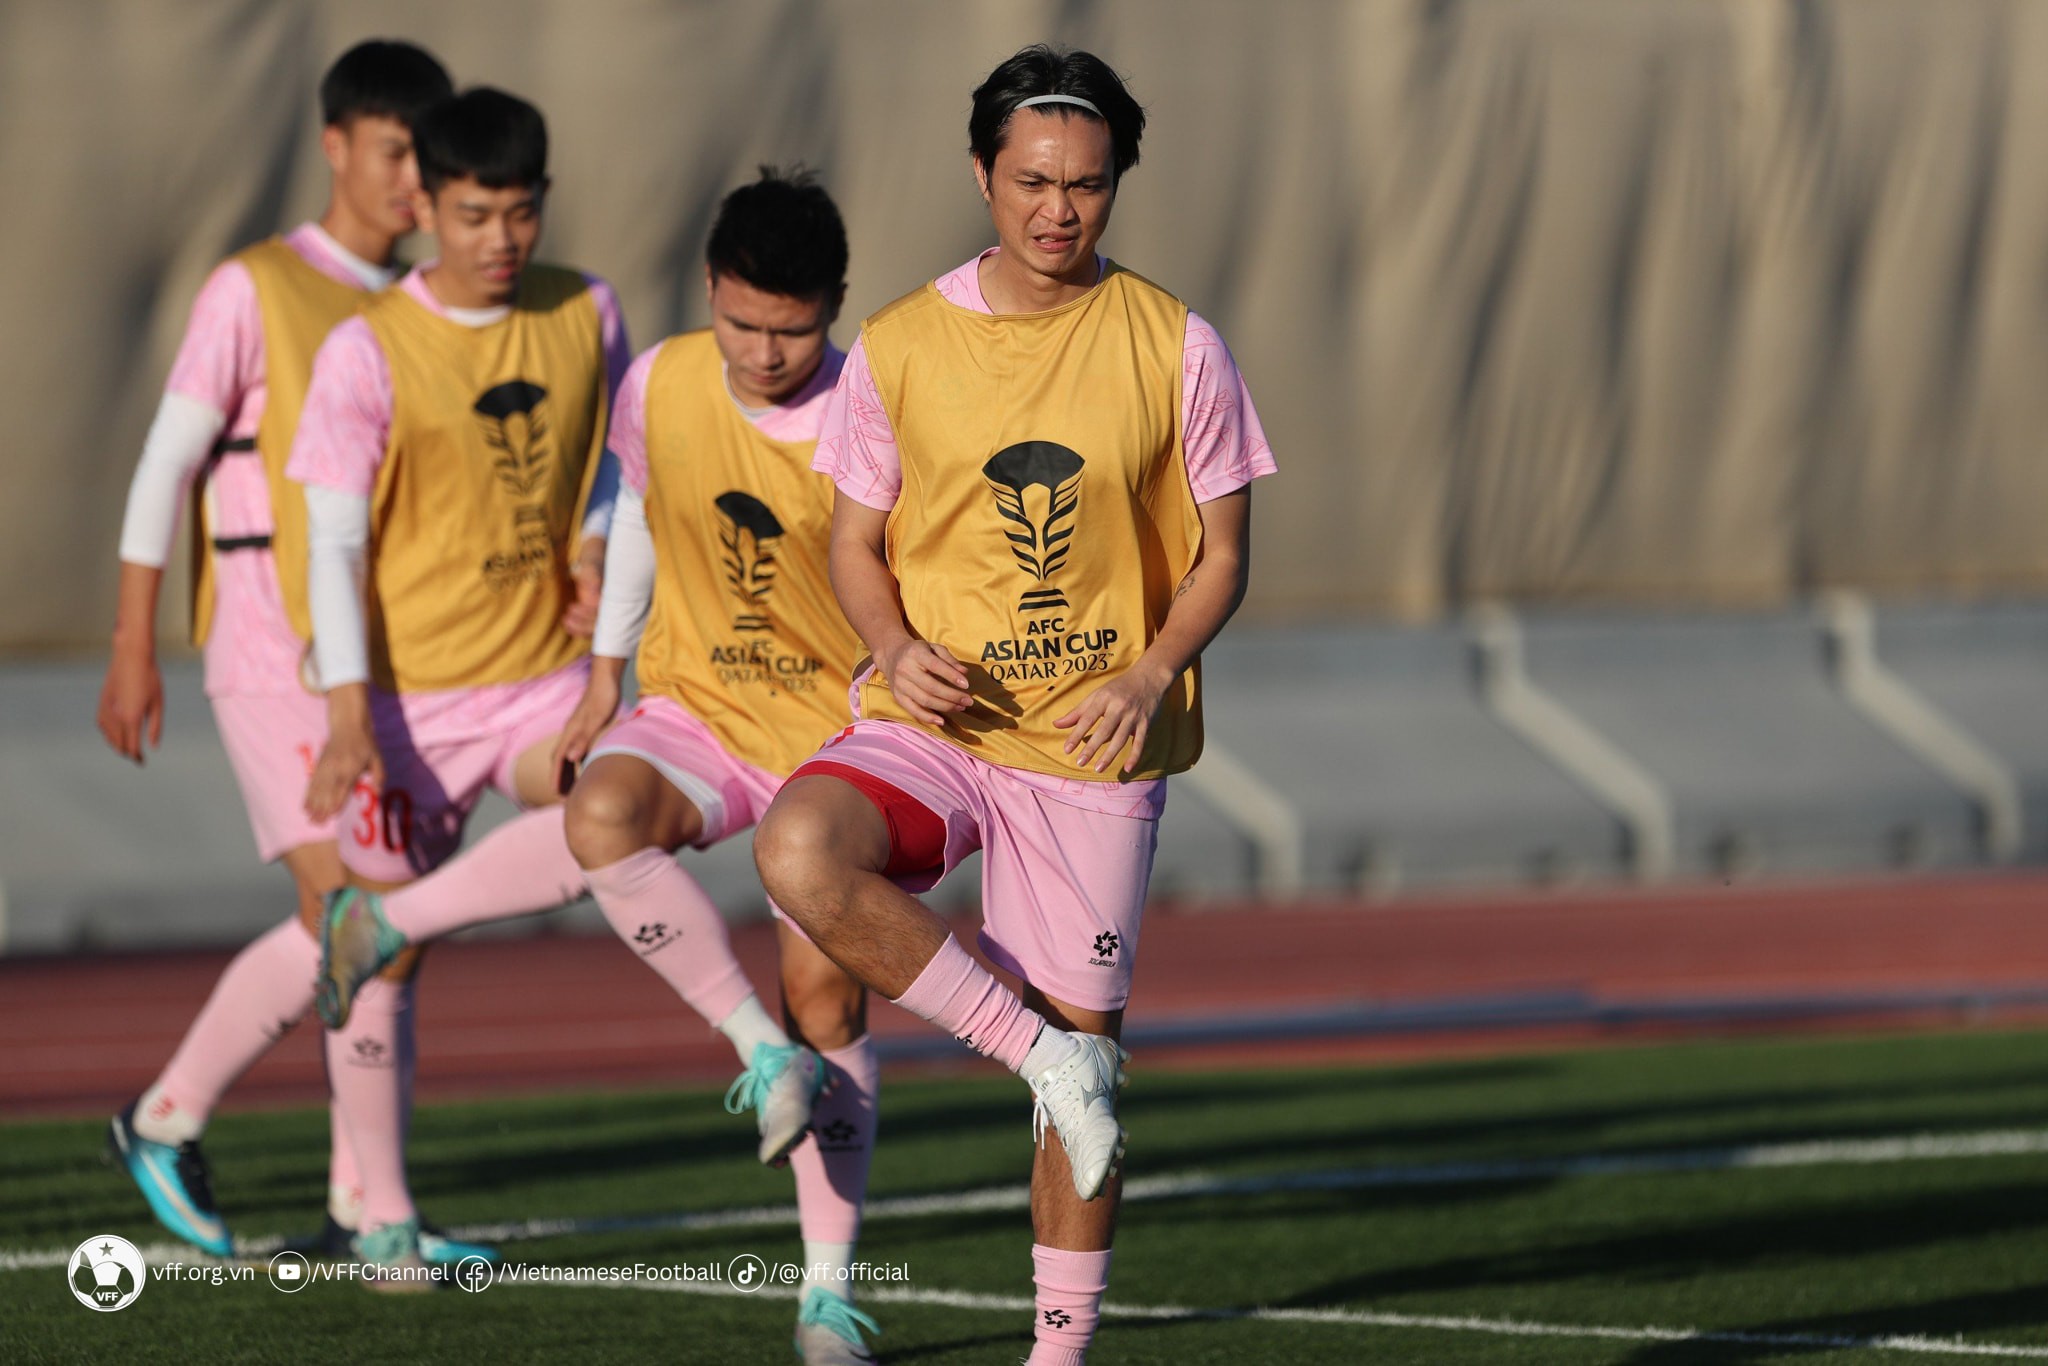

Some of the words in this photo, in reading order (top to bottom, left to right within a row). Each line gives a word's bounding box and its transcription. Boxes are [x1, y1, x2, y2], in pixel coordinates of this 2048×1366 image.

[1026, 617, 1065, 636] AFC
[980, 636, 1062, 663] ASIAN
[1065, 628, 1118, 655] CUP
[776, 656, 825, 676] CUP
[989, 661, 1058, 685] QATAR
[352, 778, 414, 855] 30
